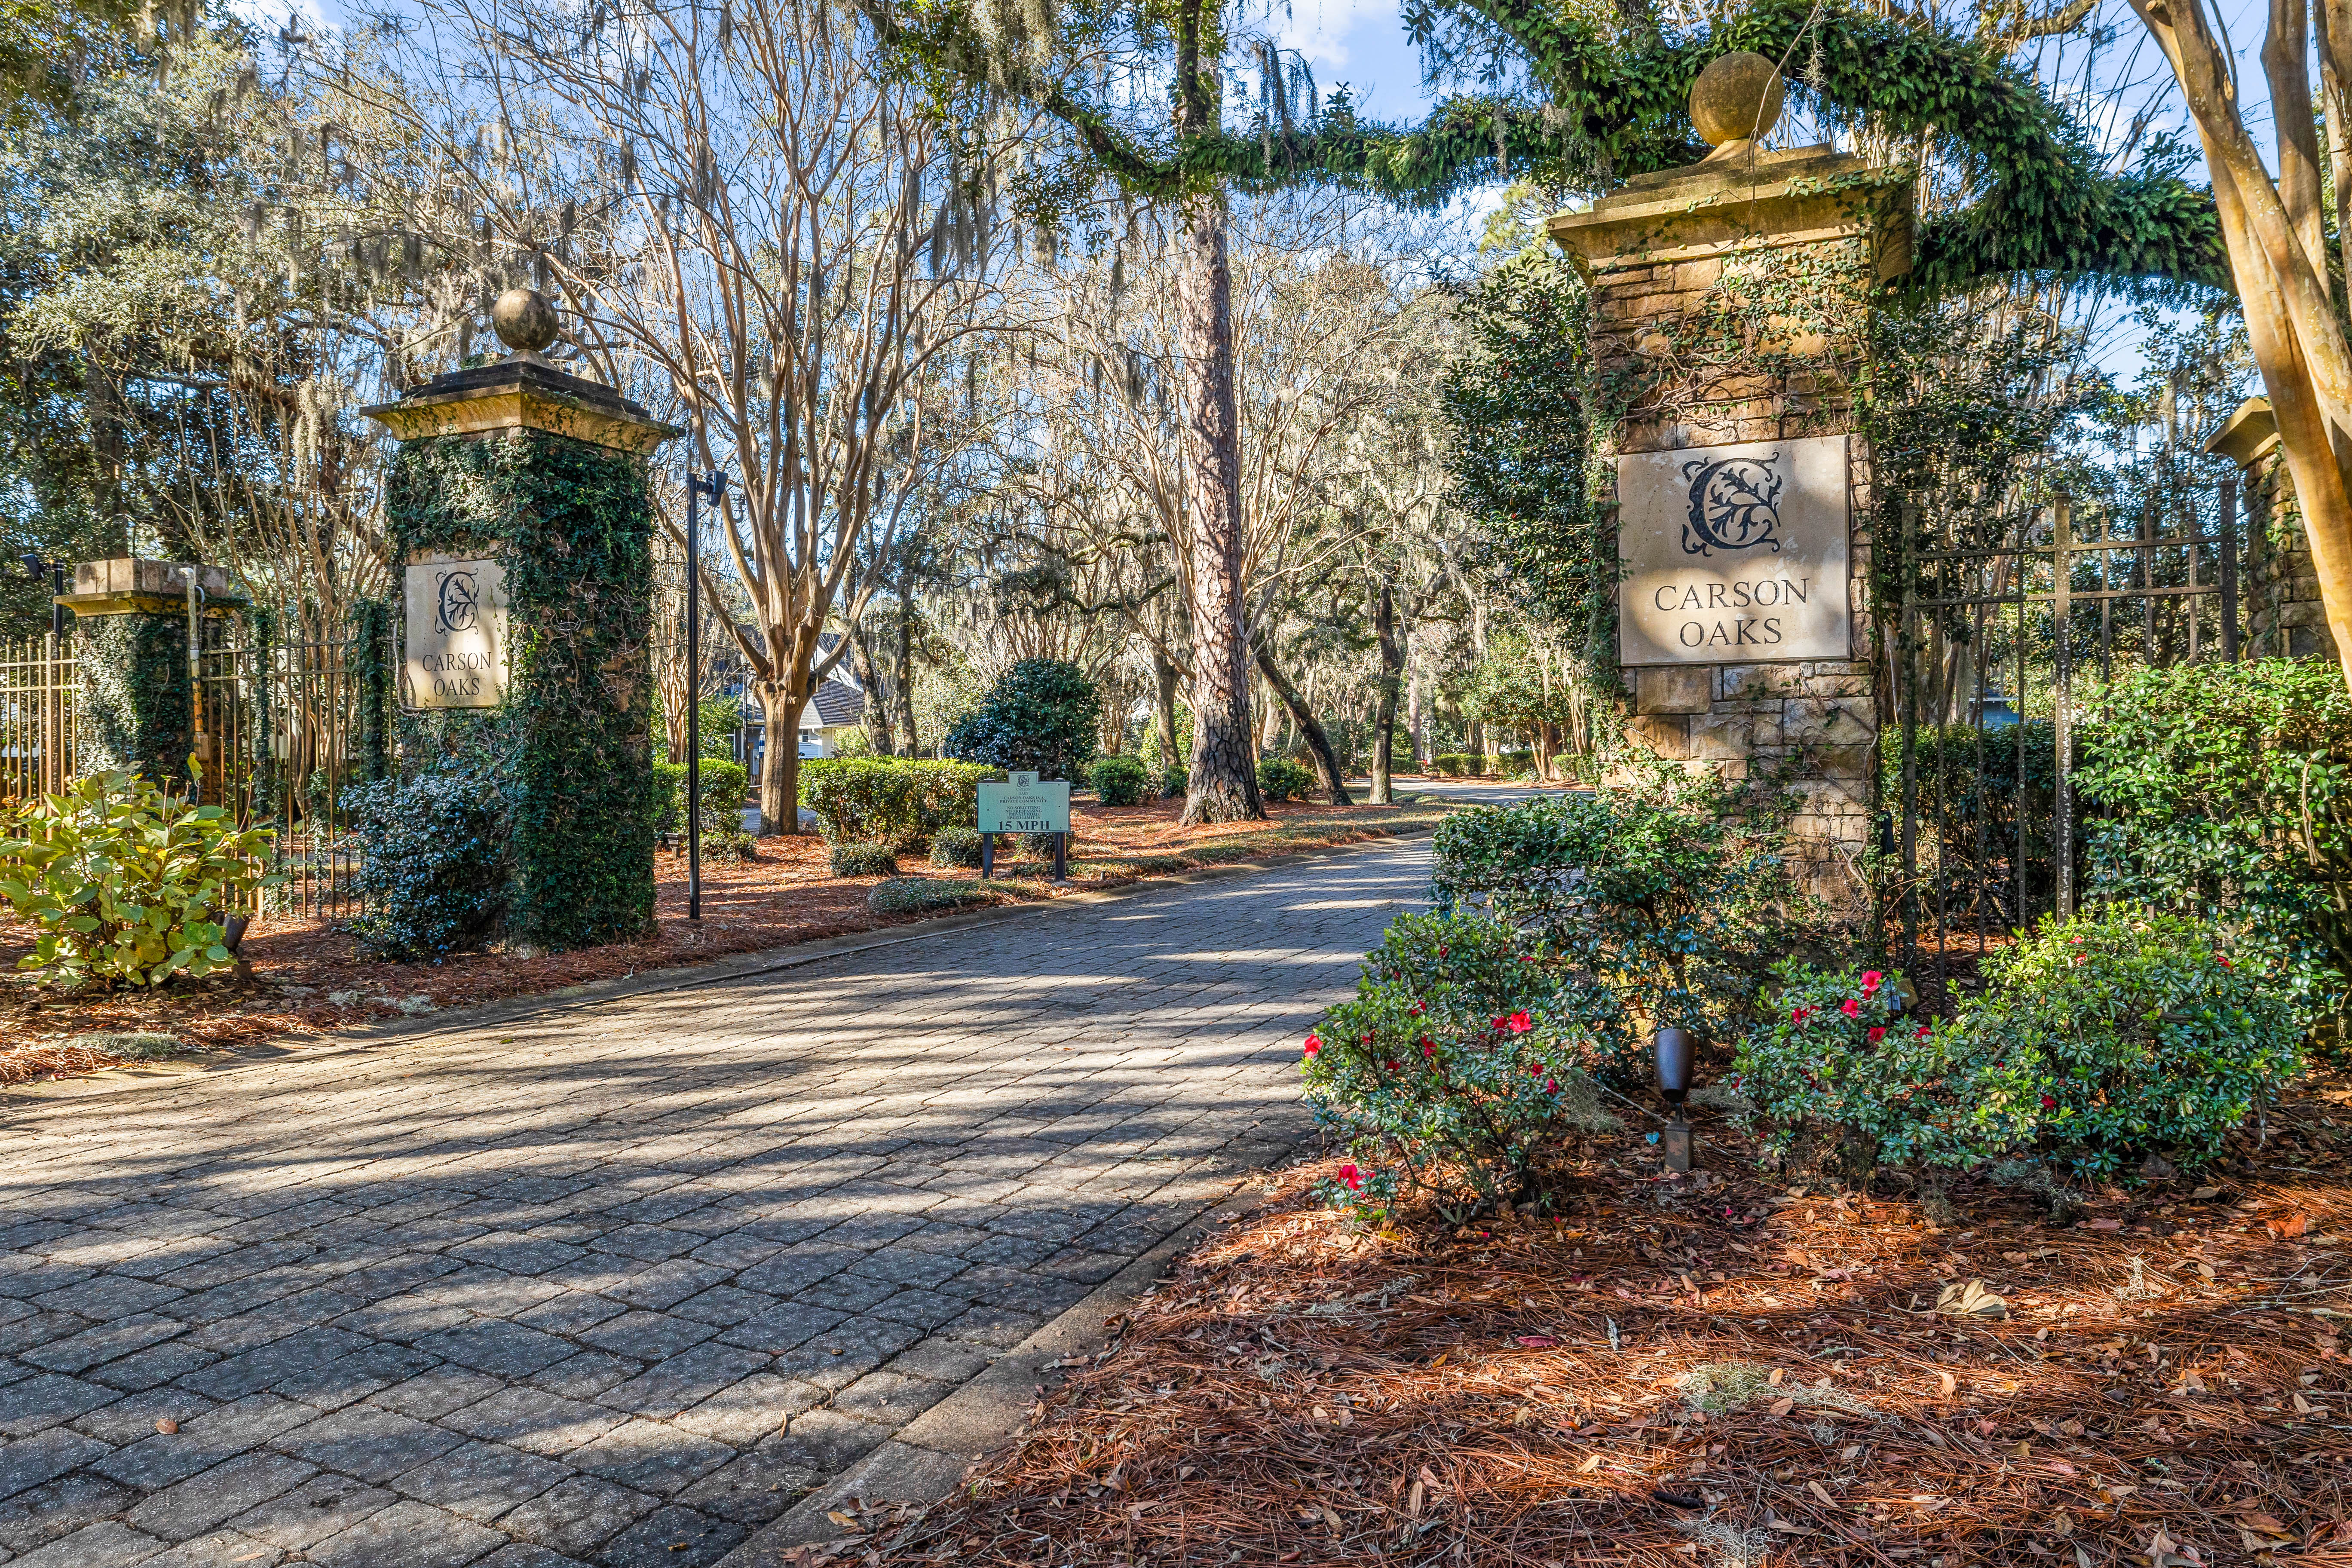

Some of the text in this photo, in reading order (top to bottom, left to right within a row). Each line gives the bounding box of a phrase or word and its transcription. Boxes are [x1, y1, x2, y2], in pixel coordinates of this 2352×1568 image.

[1655, 578, 1810, 611] CARSON
[1680, 618, 1782, 647] OAKS
[423, 652, 491, 671] CARSON
[434, 677, 480, 696] OAKS
[998, 820, 1050, 830] 15 MPH
